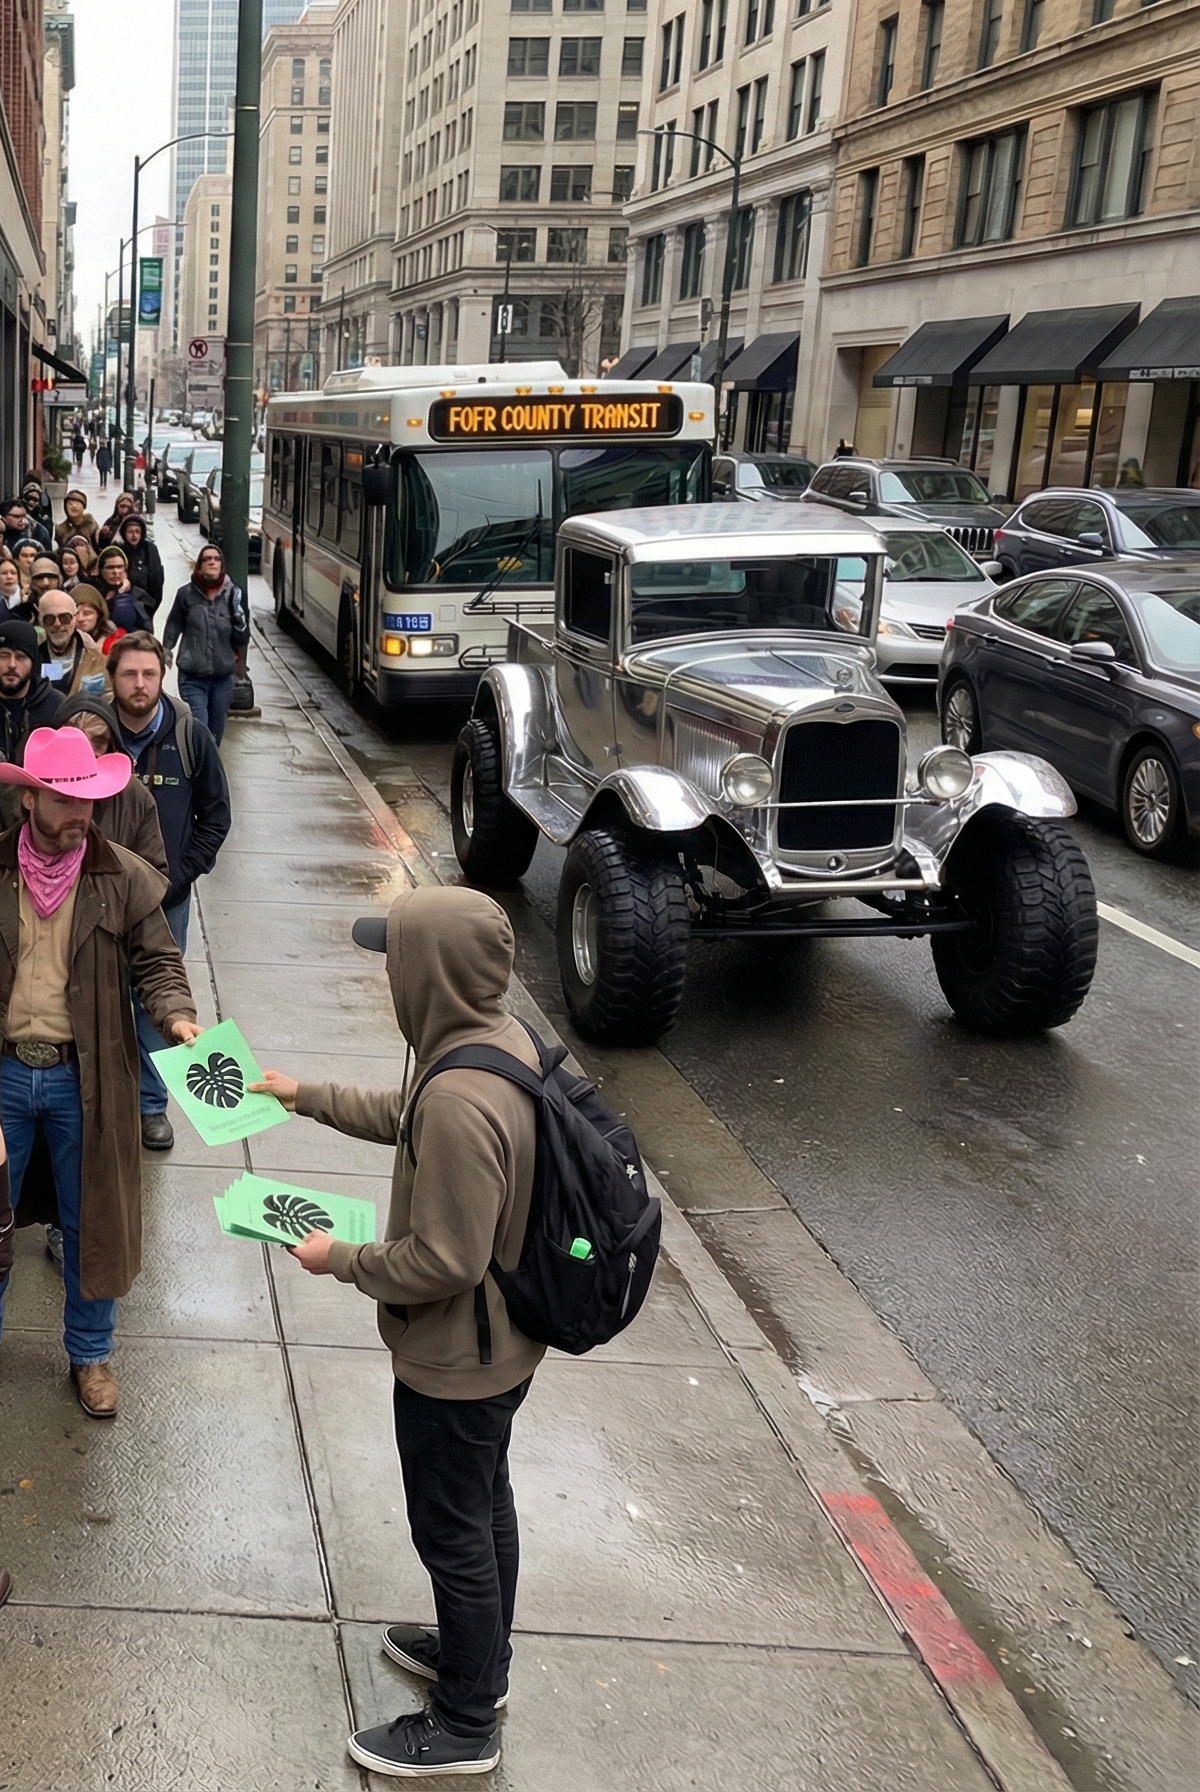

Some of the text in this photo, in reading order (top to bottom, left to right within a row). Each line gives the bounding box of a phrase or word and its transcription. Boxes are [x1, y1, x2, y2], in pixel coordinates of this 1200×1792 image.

[449, 402, 661, 432] FOFR COUNTY TRANSIT
